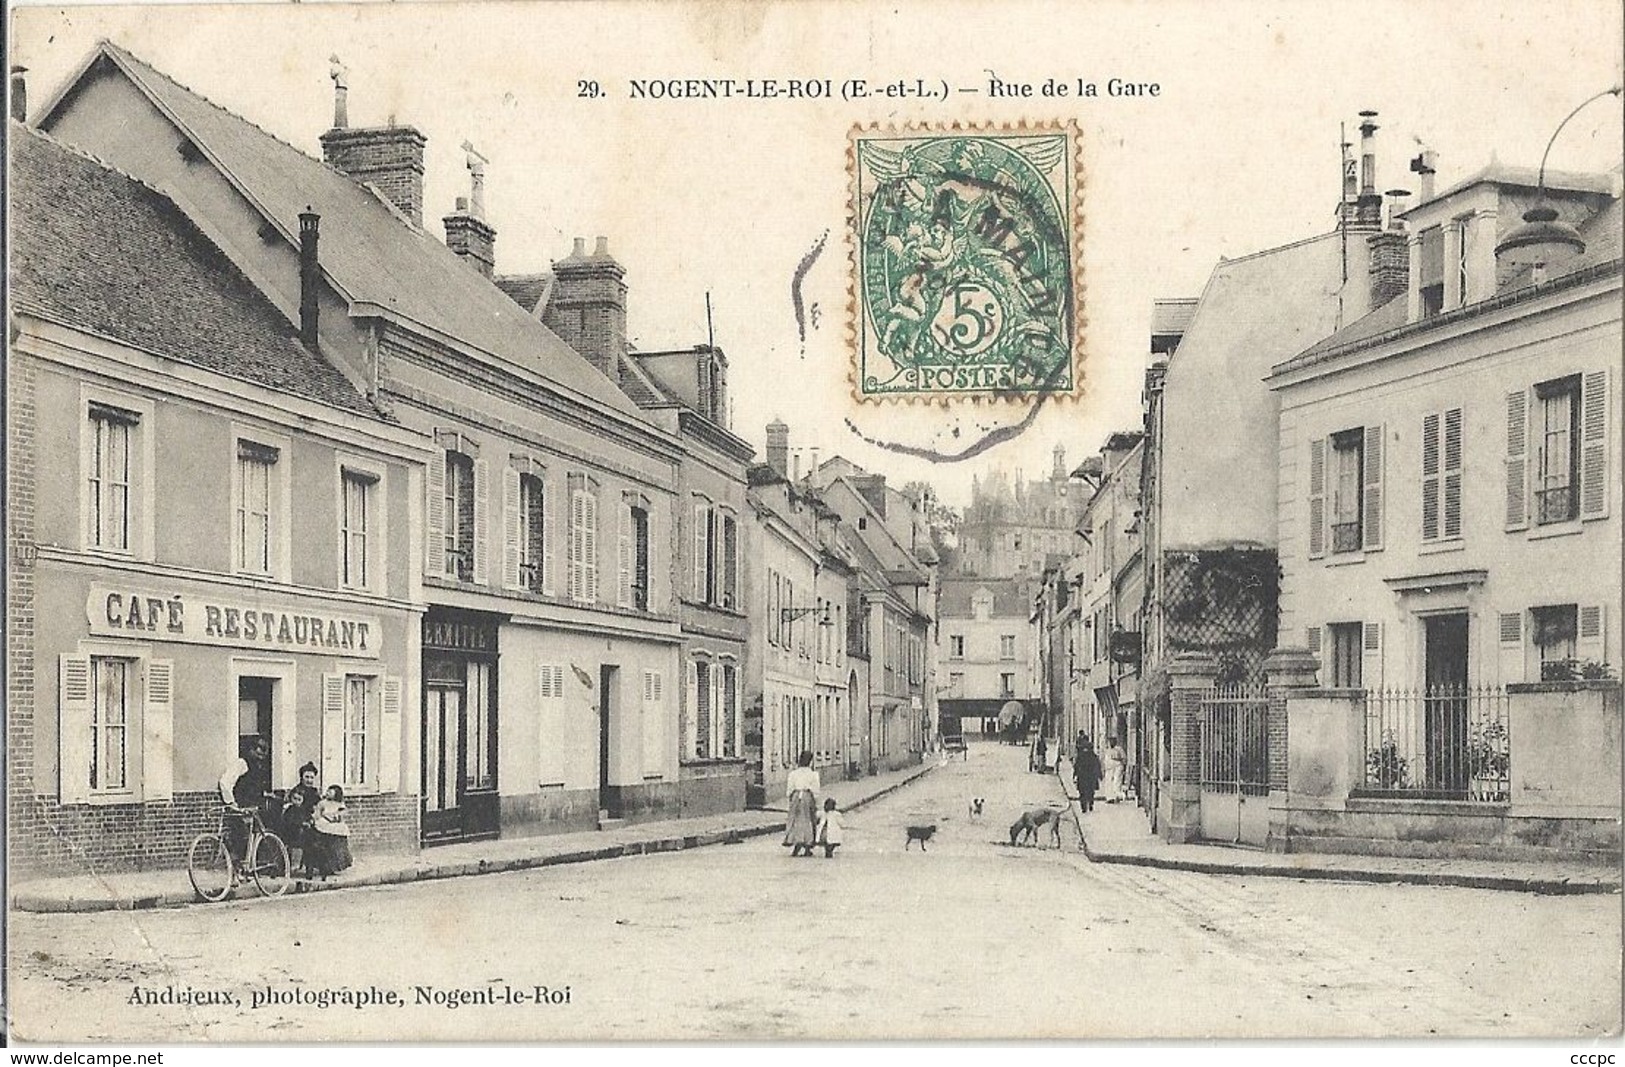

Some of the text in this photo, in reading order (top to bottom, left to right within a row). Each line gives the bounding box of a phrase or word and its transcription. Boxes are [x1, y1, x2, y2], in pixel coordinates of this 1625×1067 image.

[920, 366, 1013, 390] POSTES
[105, 592, 370, 651] CAFÉ RESTAURANT
